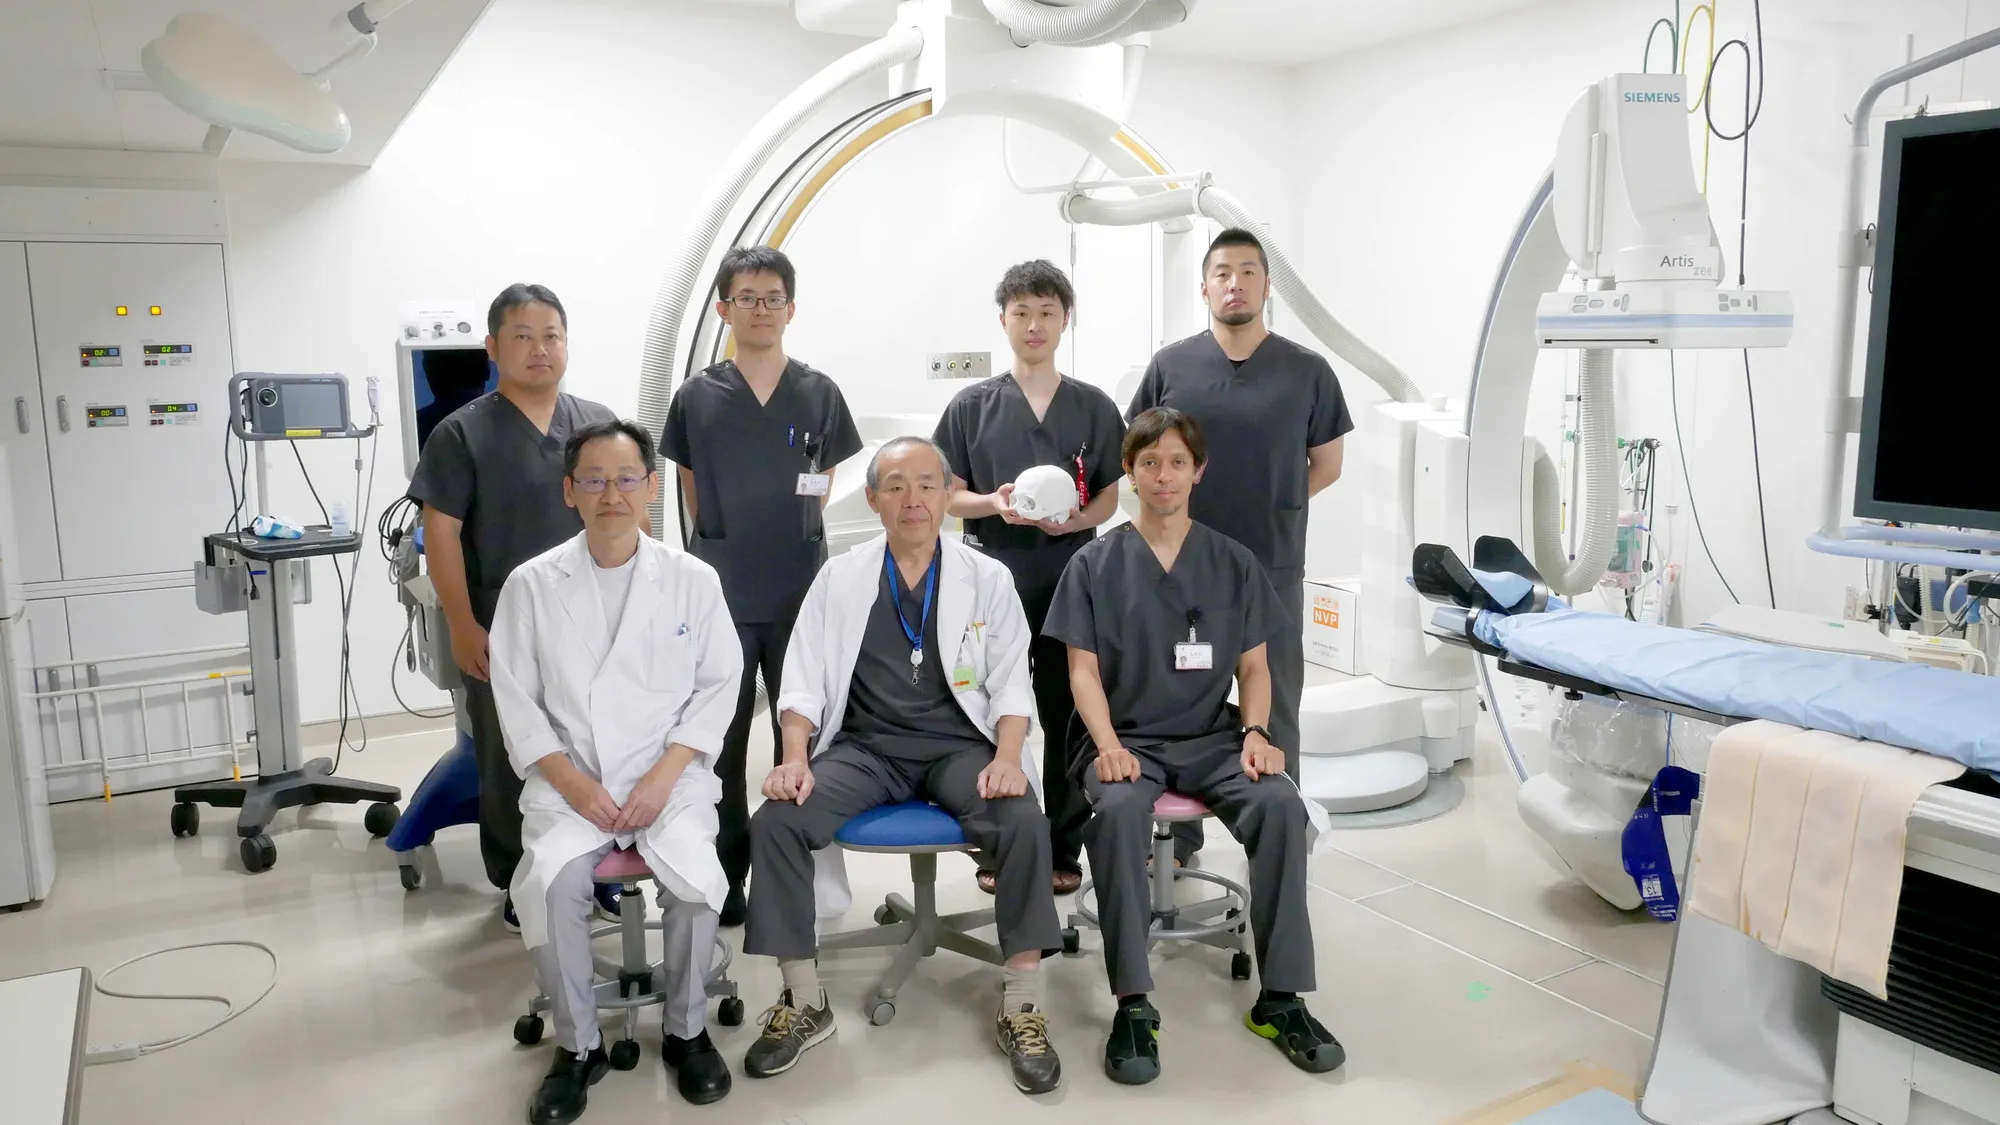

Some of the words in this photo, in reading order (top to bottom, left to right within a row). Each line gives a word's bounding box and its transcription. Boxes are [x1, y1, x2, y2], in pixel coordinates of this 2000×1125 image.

[1624, 92, 1681, 103] SIEMENS
[1660, 254, 1694, 267] Artis
[1693, 266, 1712, 276] zee
[1314, 608, 1338, 626] NVP
